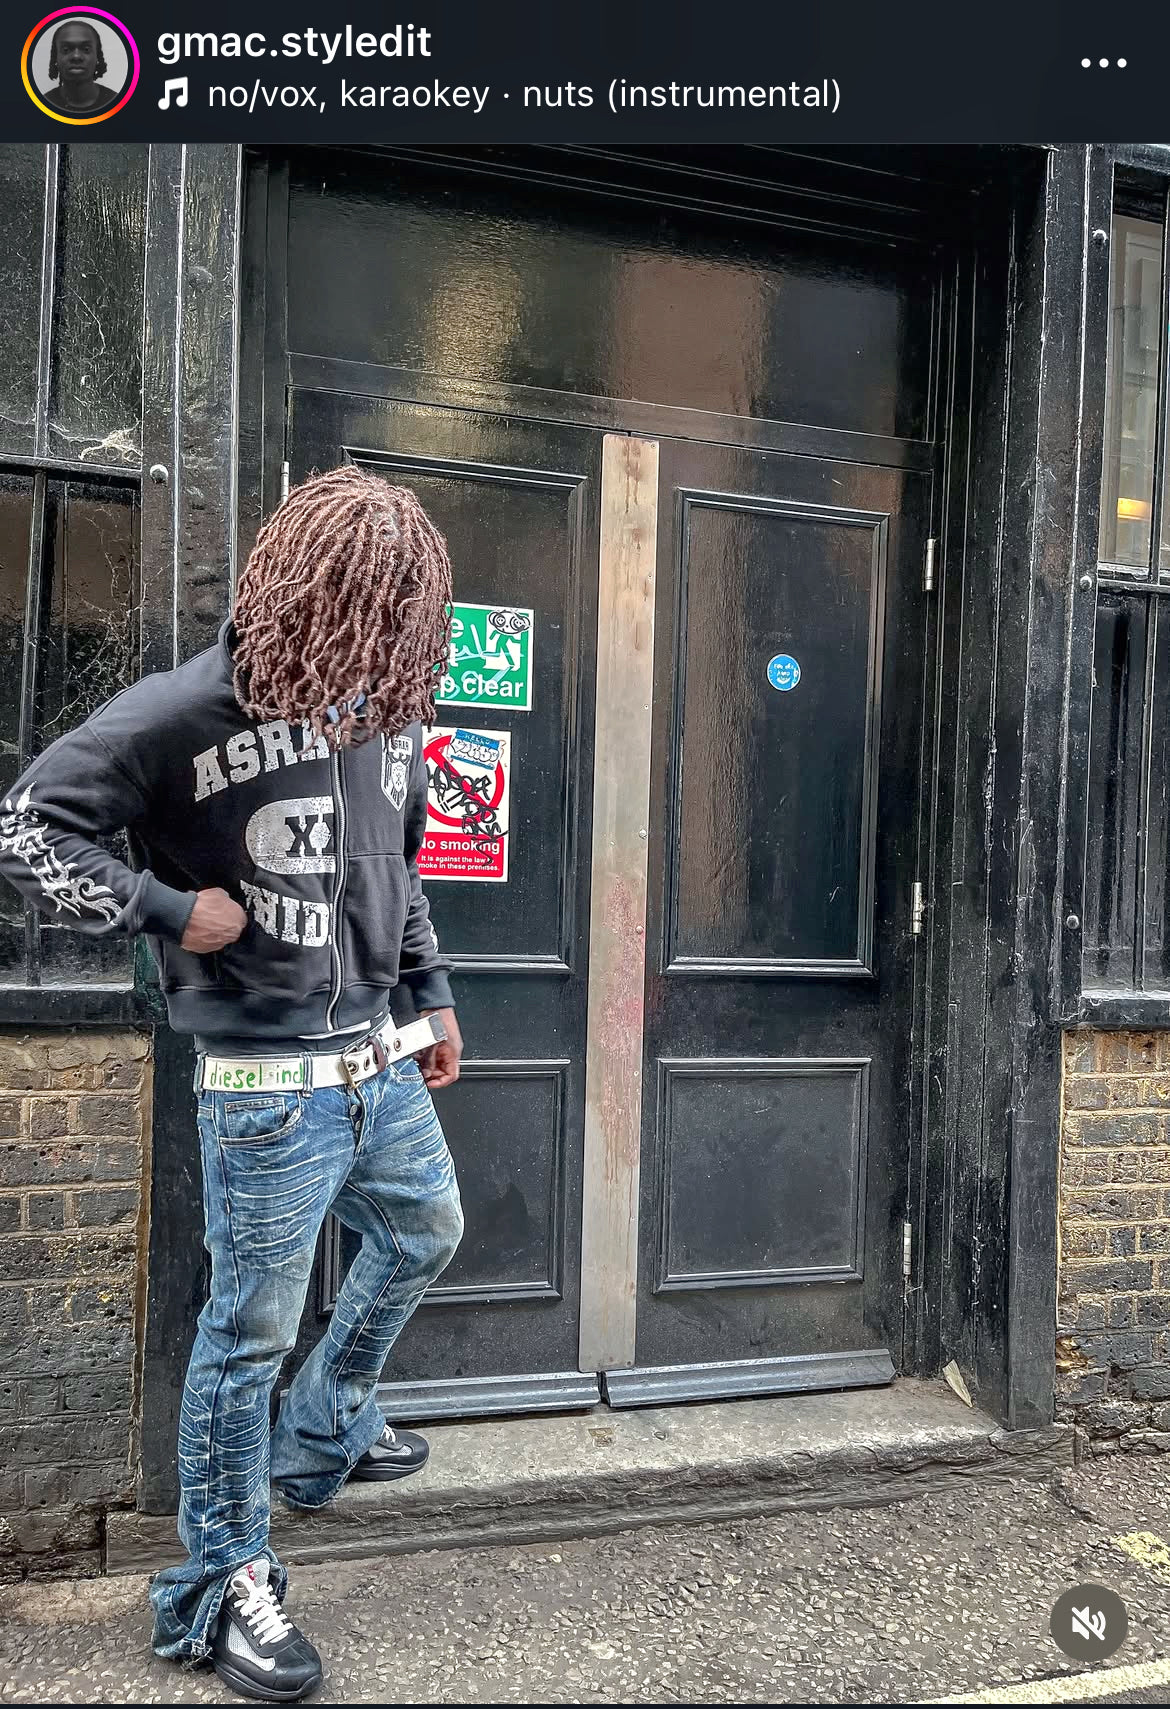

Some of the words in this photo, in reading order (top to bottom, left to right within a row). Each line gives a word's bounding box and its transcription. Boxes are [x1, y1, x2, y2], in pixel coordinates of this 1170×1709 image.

[462, 673, 524, 698] clear
[421, 854, 427, 862] It
[435, 855, 460, 864] against
[474, 856, 486, 864] law
[210, 1061, 263, 1089] diesel
